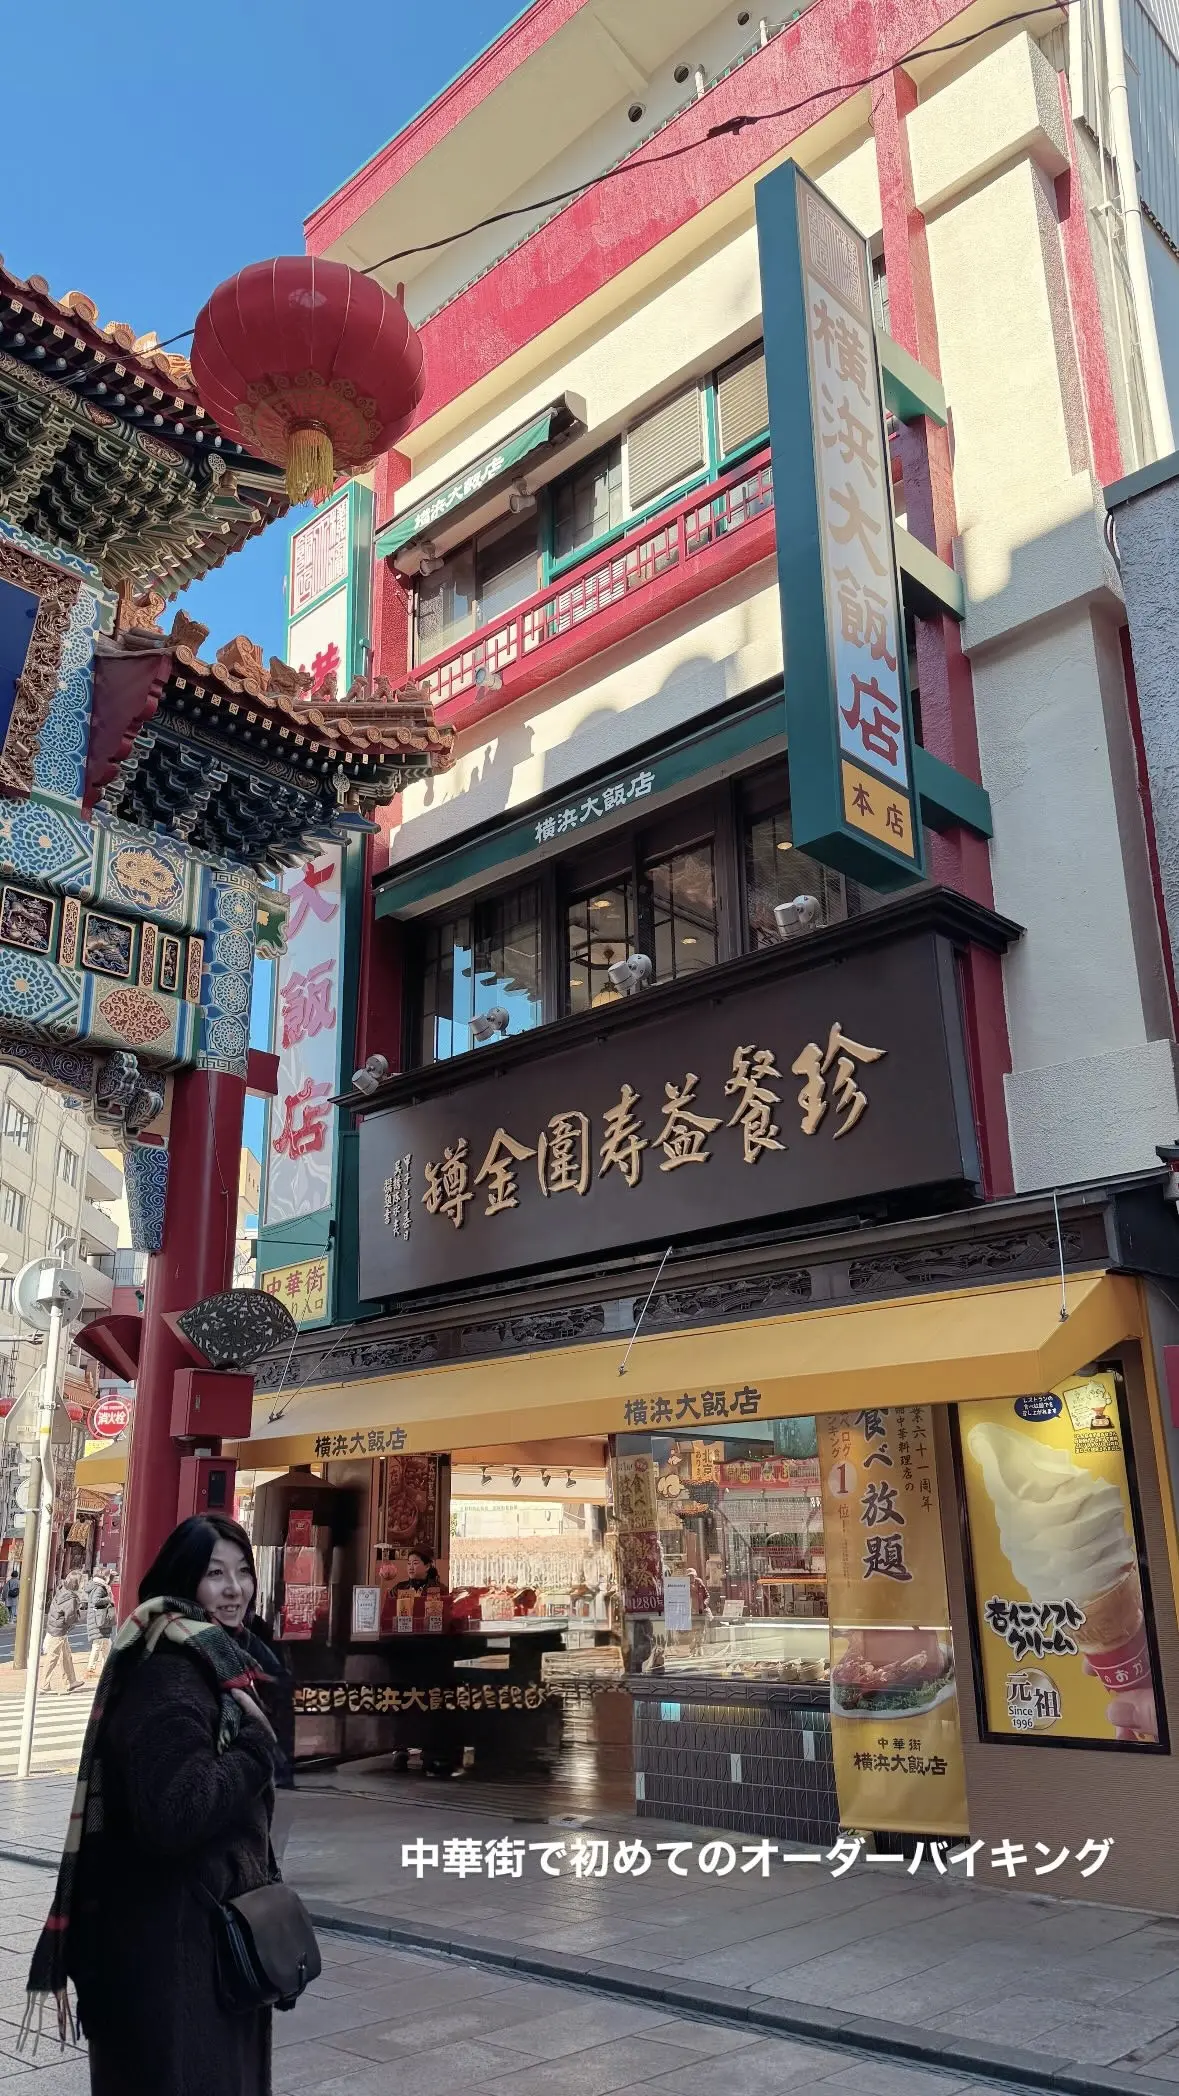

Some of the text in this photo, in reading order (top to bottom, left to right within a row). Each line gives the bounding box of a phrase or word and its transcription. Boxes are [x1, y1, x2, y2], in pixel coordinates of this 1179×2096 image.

[813, 299, 900, 768] 横浜大飯店
[534, 771, 656, 844] 横浜大飯店
[851, 783, 905, 838] 本店
[266, 1265, 326, 1299] 中華街
[97, 1410, 127, 1425] 消火栓
[624, 1385, 762, 1425] 横浜大飯店
[315, 1426, 408, 1458] 横浜大飯店
[986, 1598, 1084, 1635] 杏仁ソフト
[1008, 1628, 1075, 1659] クリーム
[1007, 1673, 1061, 1719] 元祖
[1008, 1705, 1033, 1716] Since
[1012, 1718, 1033, 1729] 1996
[877, 1737, 922, 1751] 中華街
[853, 1752, 948, 1776] 横浜大飯店
